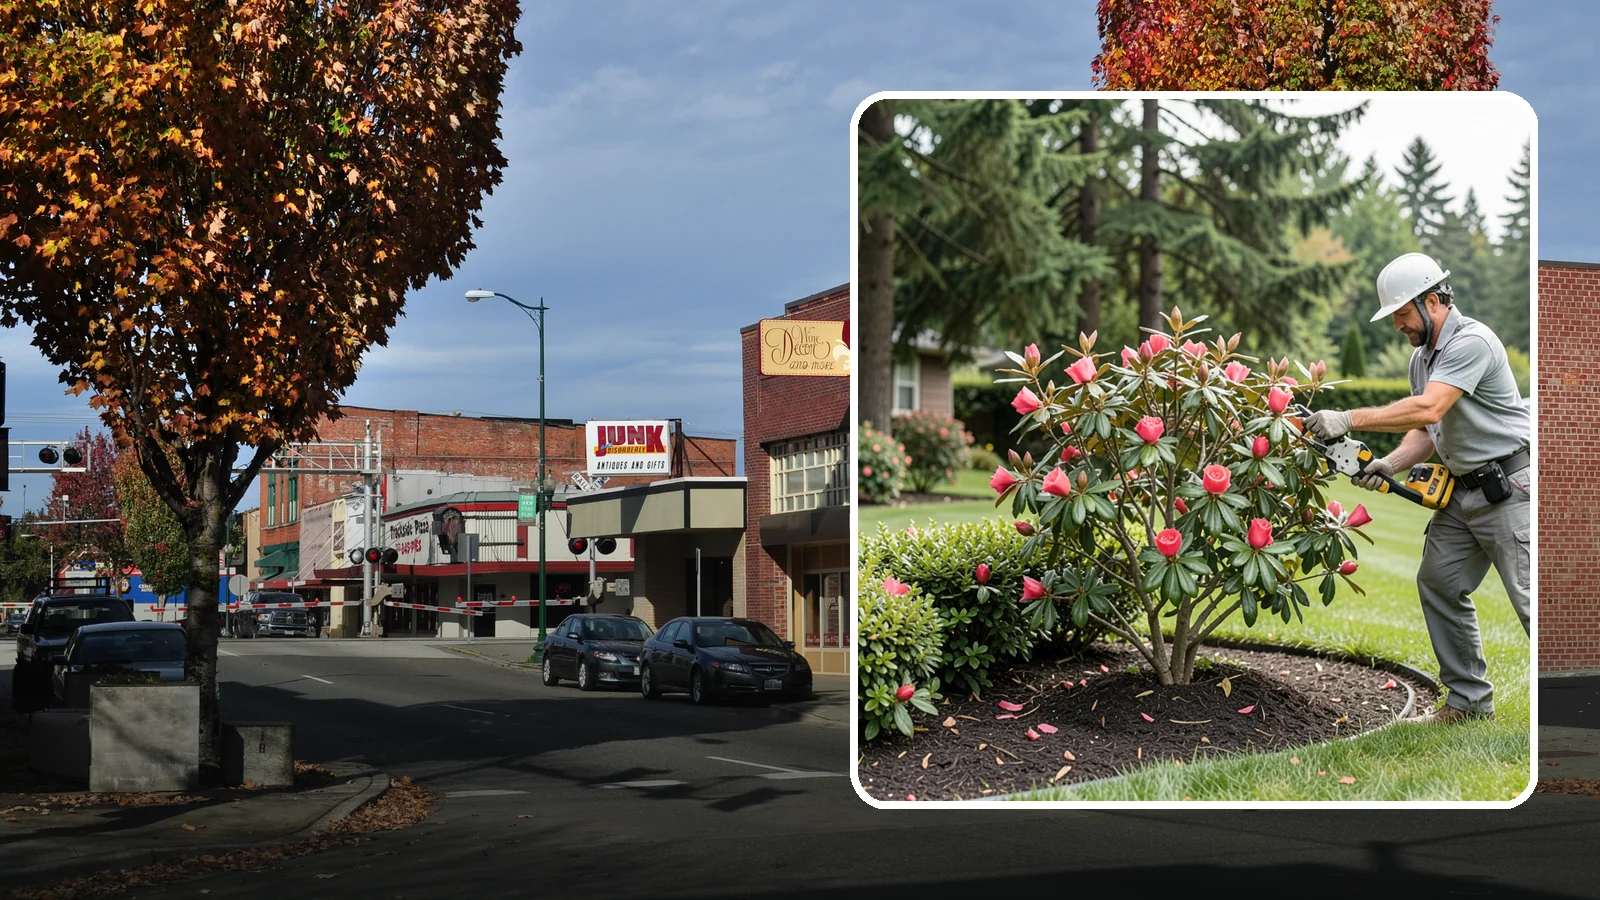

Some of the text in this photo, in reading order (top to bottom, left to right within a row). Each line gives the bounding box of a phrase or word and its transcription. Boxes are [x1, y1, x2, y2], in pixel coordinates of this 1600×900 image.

[595, 425, 665, 457] JUNK
[597, 460, 665, 470] ANTIQUES AND GIFTS
[573, 474, 589, 492] RAIL
[590, 476, 608, 491] SING
[352, 497, 364, 511] CRO
[414, 519, 429, 535] Pizza
